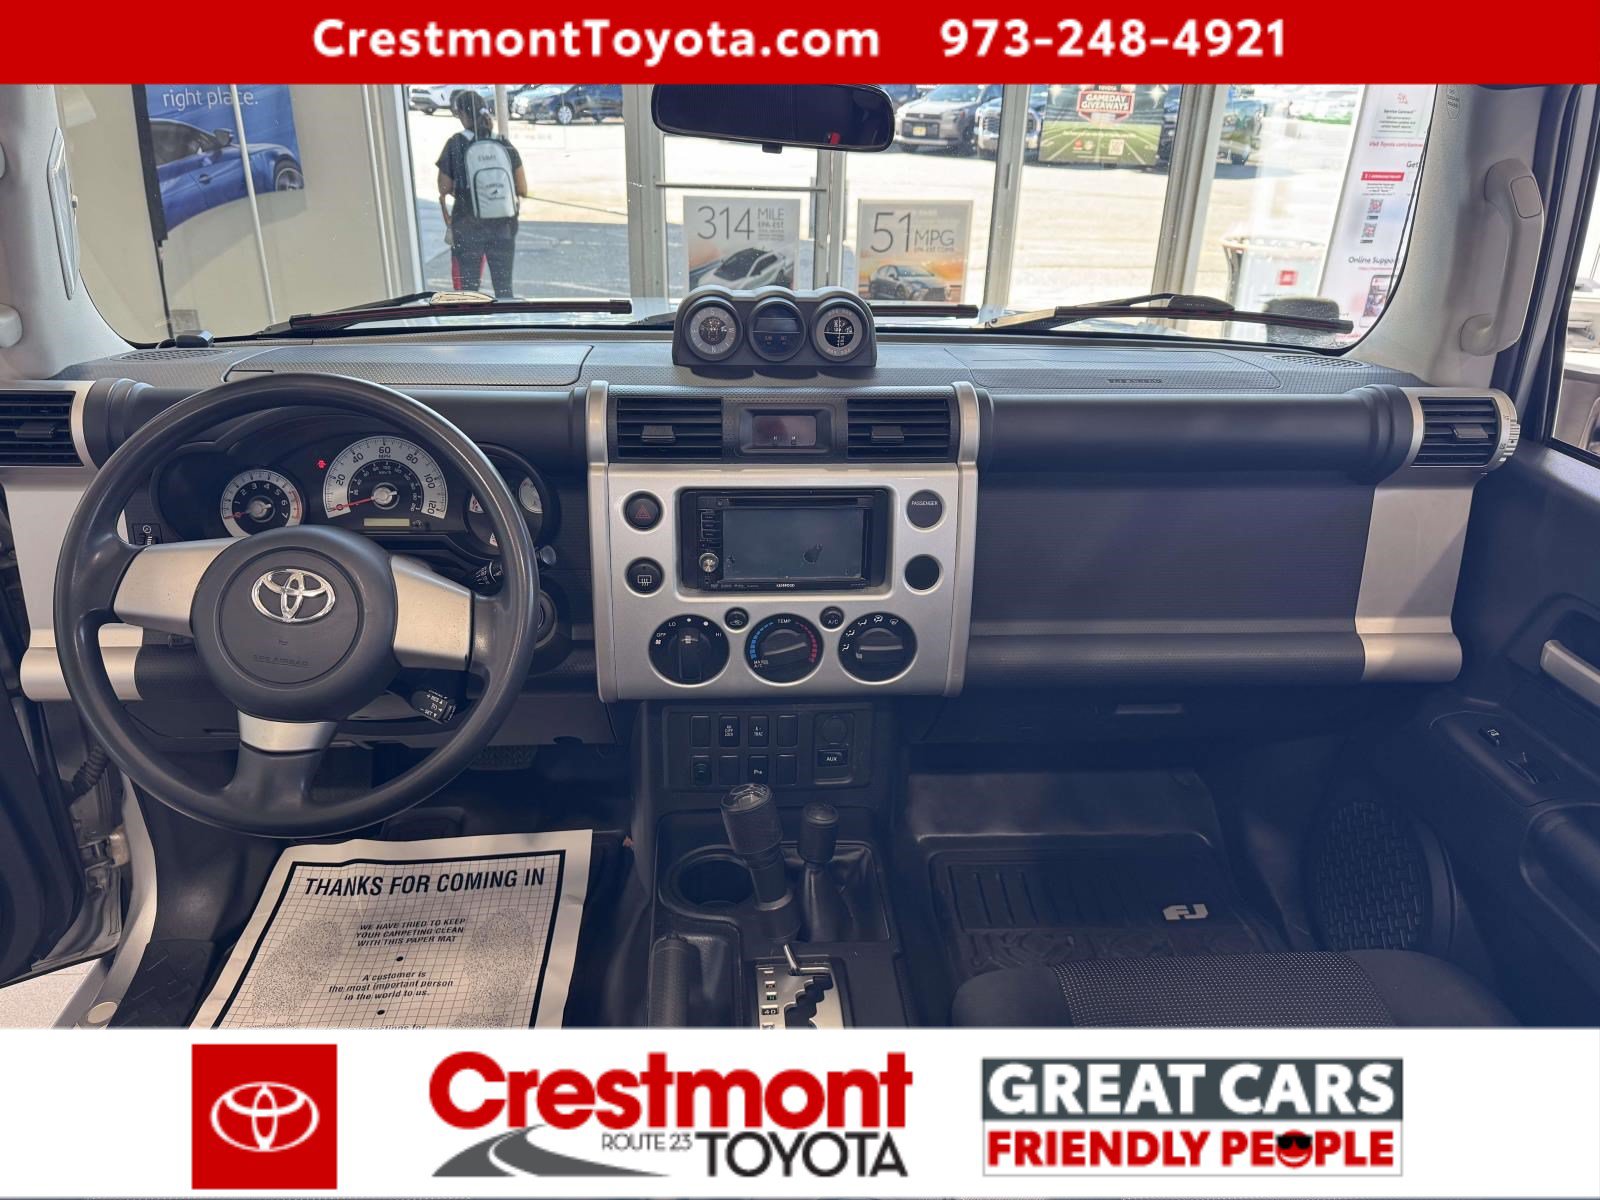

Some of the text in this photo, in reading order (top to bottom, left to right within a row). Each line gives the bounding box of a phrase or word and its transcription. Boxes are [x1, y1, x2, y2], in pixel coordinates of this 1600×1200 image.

[163, 88, 202, 111] right
[1081, 101, 1129, 111] GIVEAWAYS
[758, 208, 784, 220] MILE
[697, 206, 755, 240] 314
[870, 212, 911, 253] 51
[914, 229, 955, 247] MPG
[379, 446, 391, 454] 60
[352, 452, 364, 464] 40
[406, 453, 418, 465] 80
[251, 482, 258, 490] 3
[336, 474, 346, 487] 20
[424, 473, 436, 489] 100
[240, 488, 247, 496] 2
[274, 488, 282, 496] 5
[427, 500, 437, 515] 120
[304, 868, 545, 896] THANKS FOR COMING IN
[1163, 903, 1208, 920] FJ
[375, 922, 399, 930] HAVE
[401, 920, 427, 929] TRIED
[383, 928, 433, 938] CARPETING
[435, 926, 464, 934] CLEAN
[406, 935, 435, 944] PAPER
[371, 971, 415, 981] customer
[328, 980, 454, 993] the most important person
[356, 992, 372, 1000] the
[374, 990, 401, 999] world
